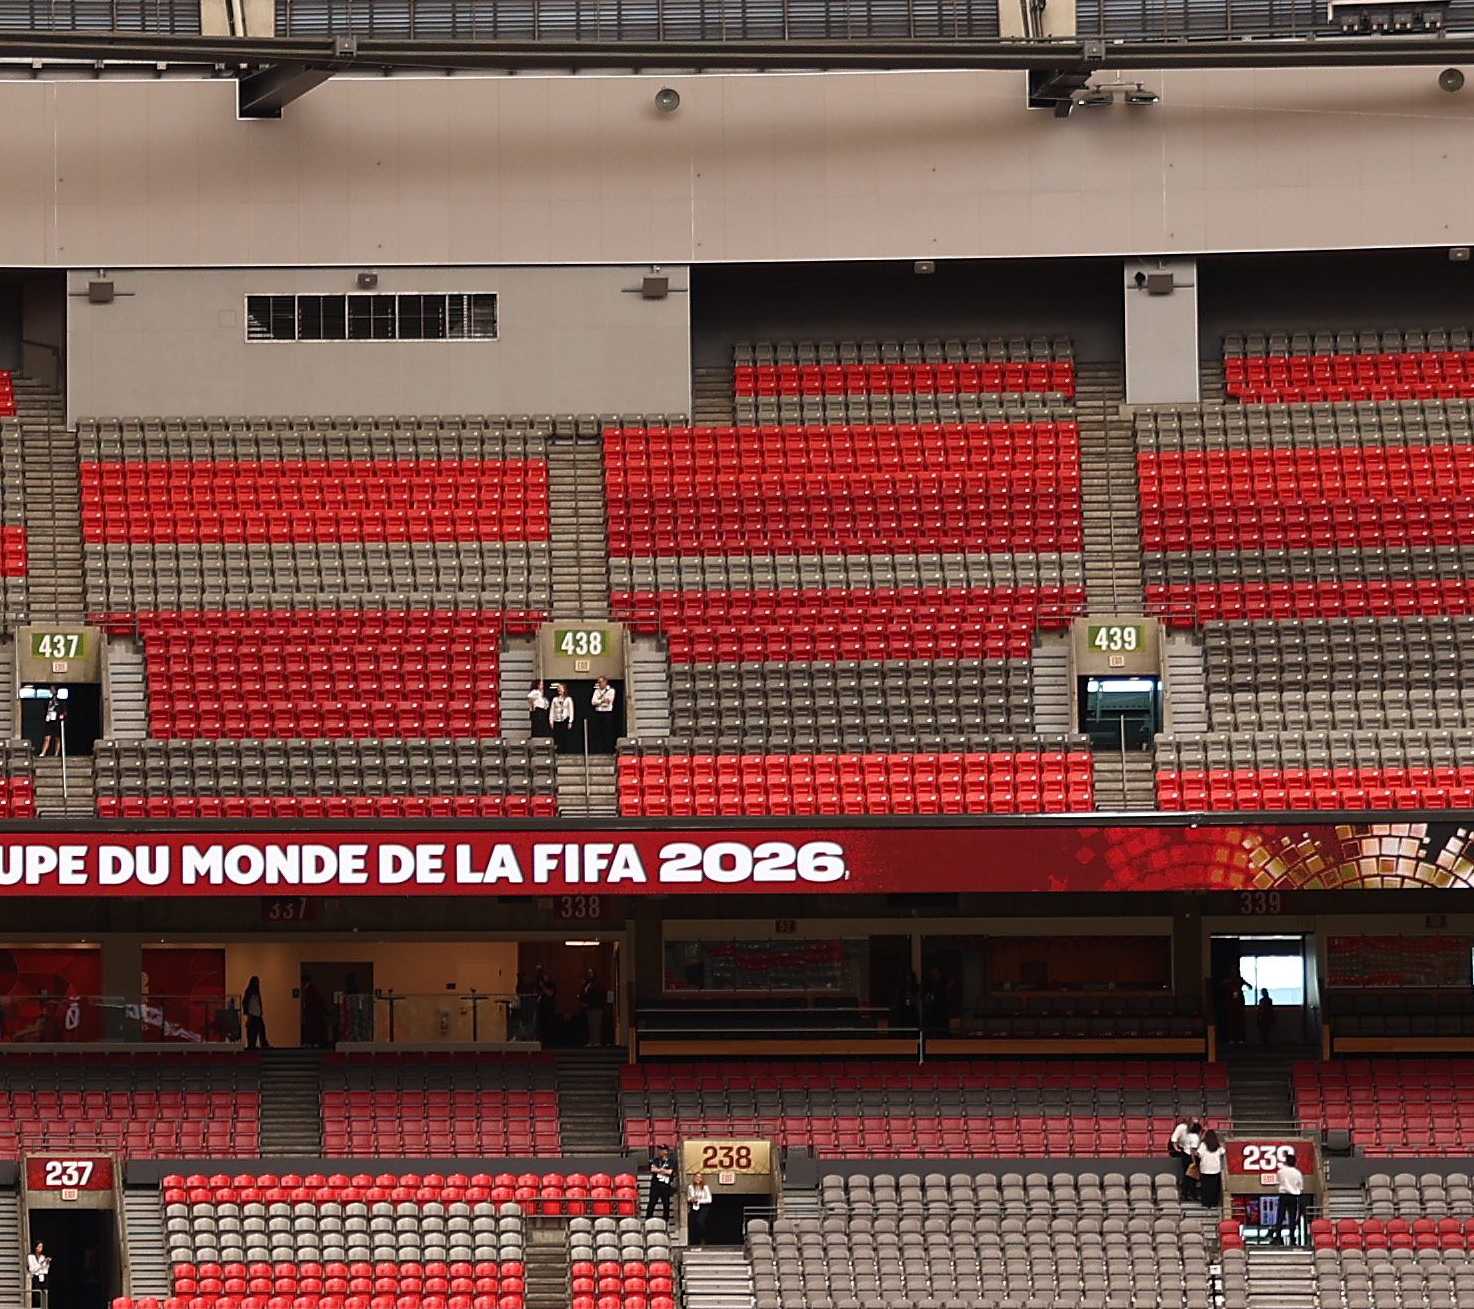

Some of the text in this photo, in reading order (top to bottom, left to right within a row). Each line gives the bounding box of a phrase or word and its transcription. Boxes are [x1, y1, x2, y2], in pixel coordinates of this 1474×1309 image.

[39, 634, 79, 657] 437
[561, 631, 602, 655] 438
[1095, 627, 1137, 650] 439
[98, 844, 171, 885] DU
[182, 844, 369, 885] MONDE
[379, 843, 447, 883] DE
[456, 843, 524, 883] LA
[533, 843, 647, 883] FIFA
[658, 841, 845, 883] 2026
[561, 896, 600, 919] 338
[1241, 890, 1281, 914] 339
[703, 1146, 752, 1170] 238
[45, 1160, 94, 1186] 237
